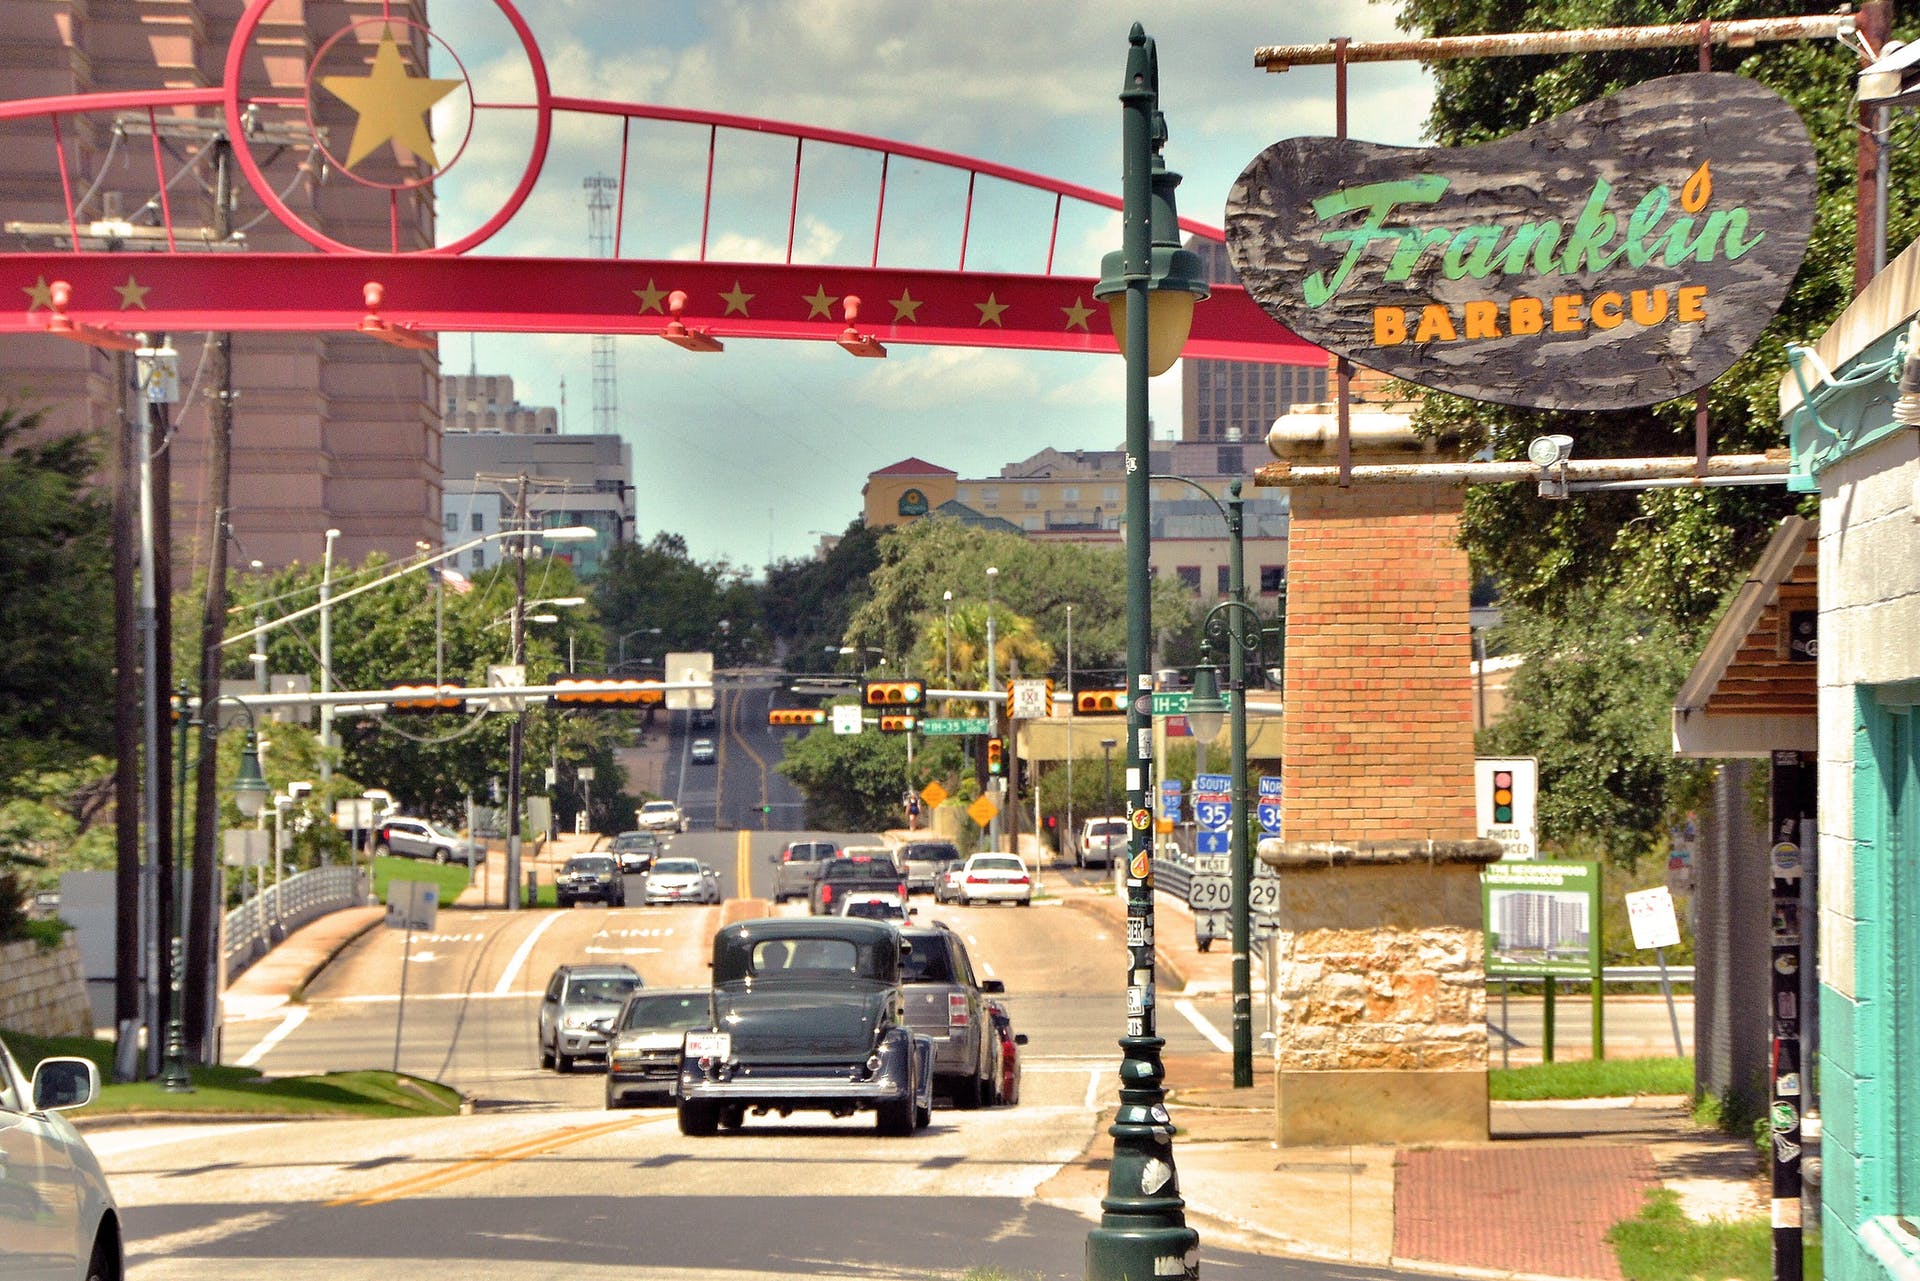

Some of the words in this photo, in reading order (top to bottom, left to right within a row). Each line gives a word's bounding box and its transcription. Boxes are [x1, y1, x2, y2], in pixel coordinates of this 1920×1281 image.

[1301, 159, 1766, 308] Franklin
[1372, 285, 1708, 347] BARBECUE
[1153, 697, 1189, 712] IH-3
[1199, 776, 1231, 791] SOUTH
[1261, 779, 1282, 793] NOR
[1201, 805, 1227, 825] 35
[1487, 829, 1520, 840] PHOTO
[1200, 859, 1225, 870] WEST
[1193, 883, 1230, 903] 290
[1252, 885, 1277, 905] 29
